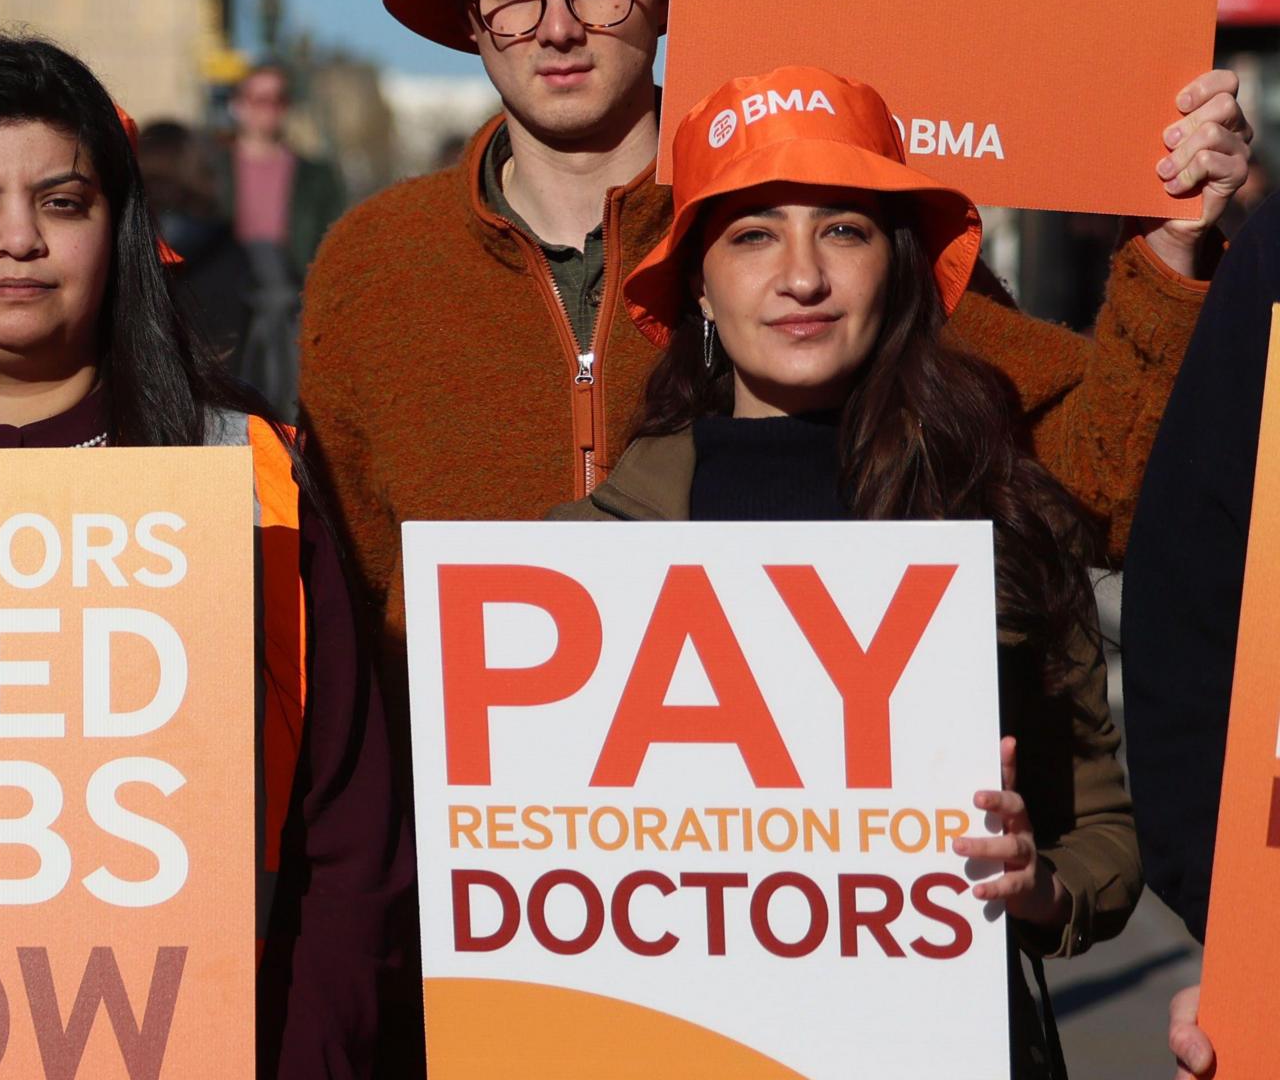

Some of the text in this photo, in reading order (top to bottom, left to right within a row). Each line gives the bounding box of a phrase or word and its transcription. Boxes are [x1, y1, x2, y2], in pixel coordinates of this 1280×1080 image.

[741, 89, 836, 125] BMA
[909, 119, 1004, 160] BMA
[437, 564, 959, 789] PAY
[448, 805, 970, 853] RESTORATION FOR
[452, 869, 973, 960] DOCTORS
